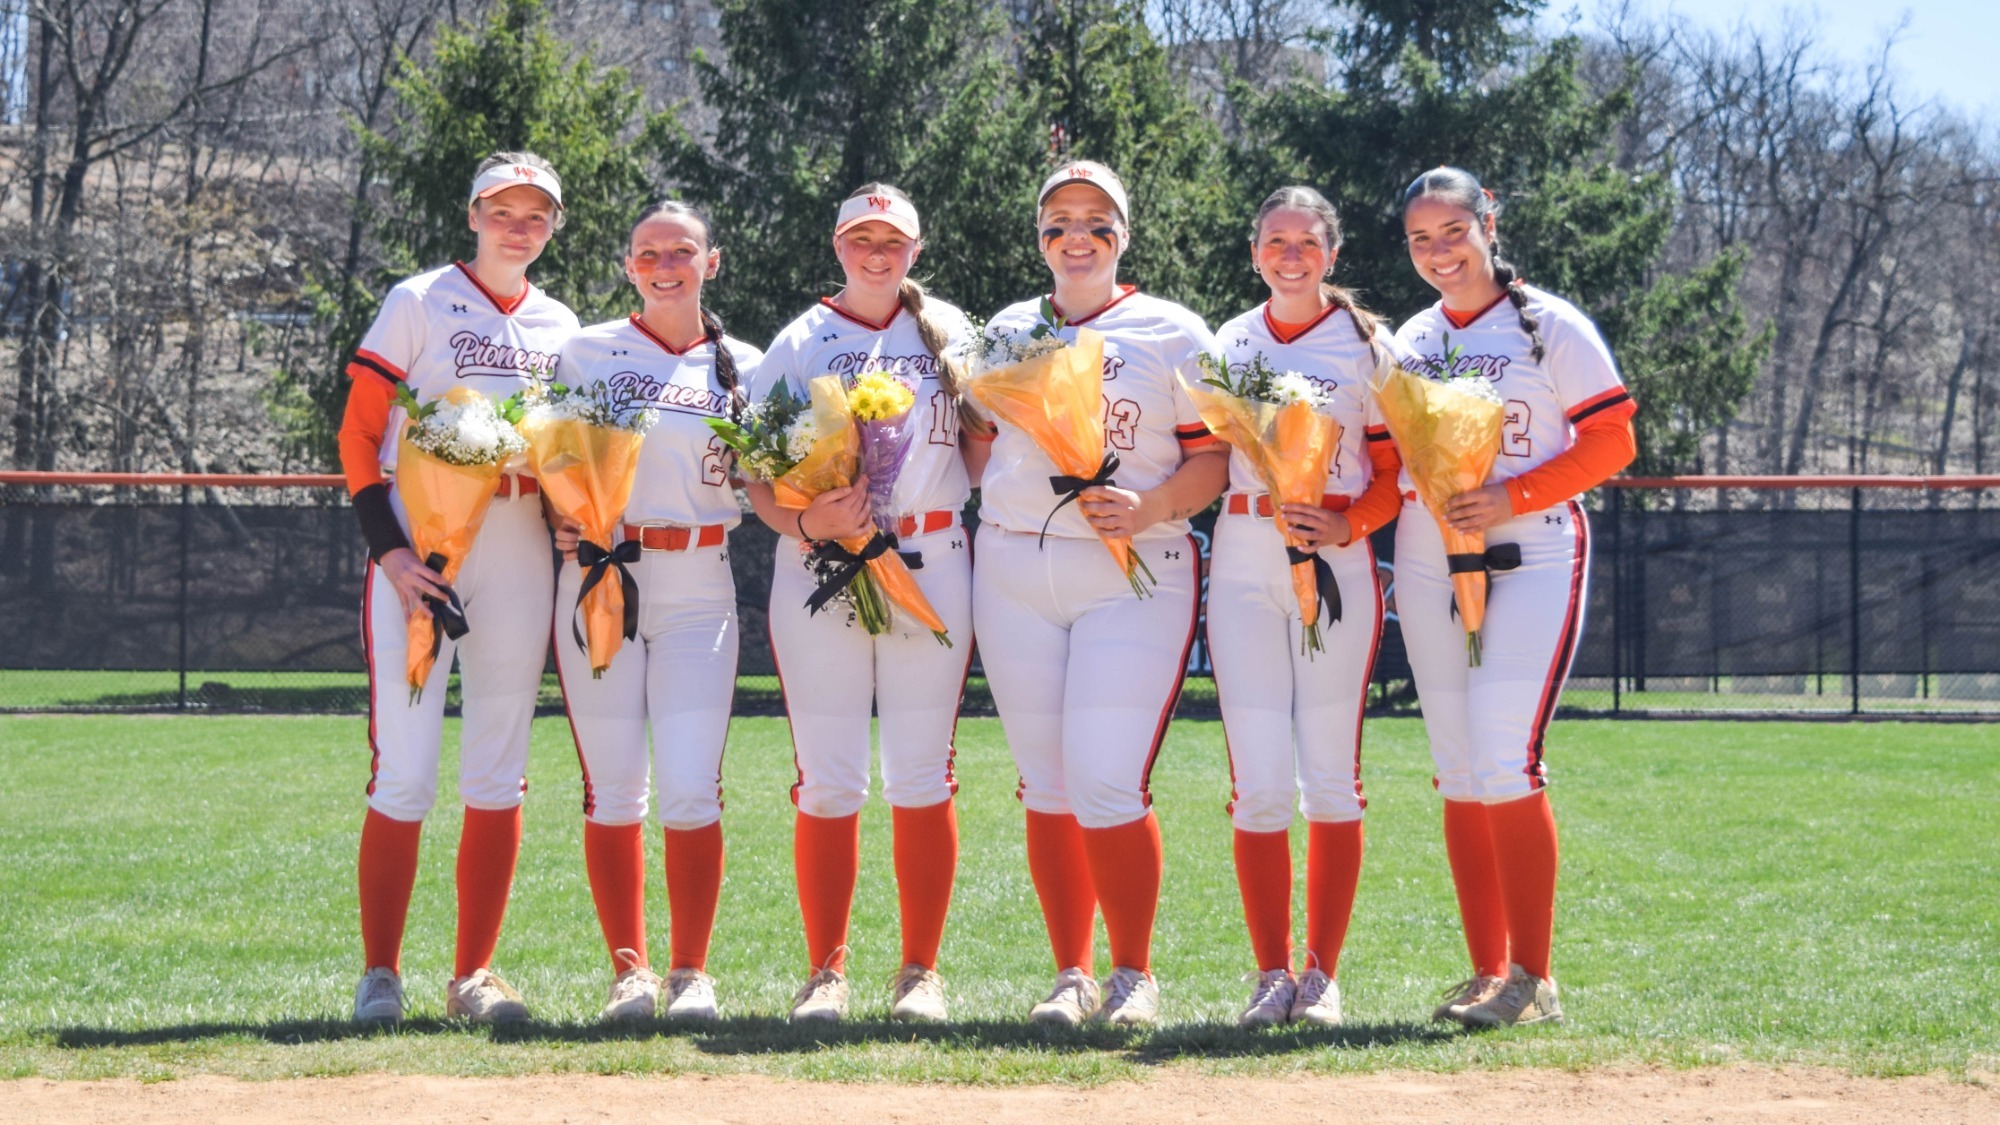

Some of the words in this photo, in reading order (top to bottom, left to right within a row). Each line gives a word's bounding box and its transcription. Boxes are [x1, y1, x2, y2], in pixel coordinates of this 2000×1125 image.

[867, 196, 892, 214] WP
[450, 330, 561, 382] Pioneers
[828, 352, 941, 380] Pioneer
[609, 371, 732, 419] Pioneers
[1497, 399, 1532, 458] 2
